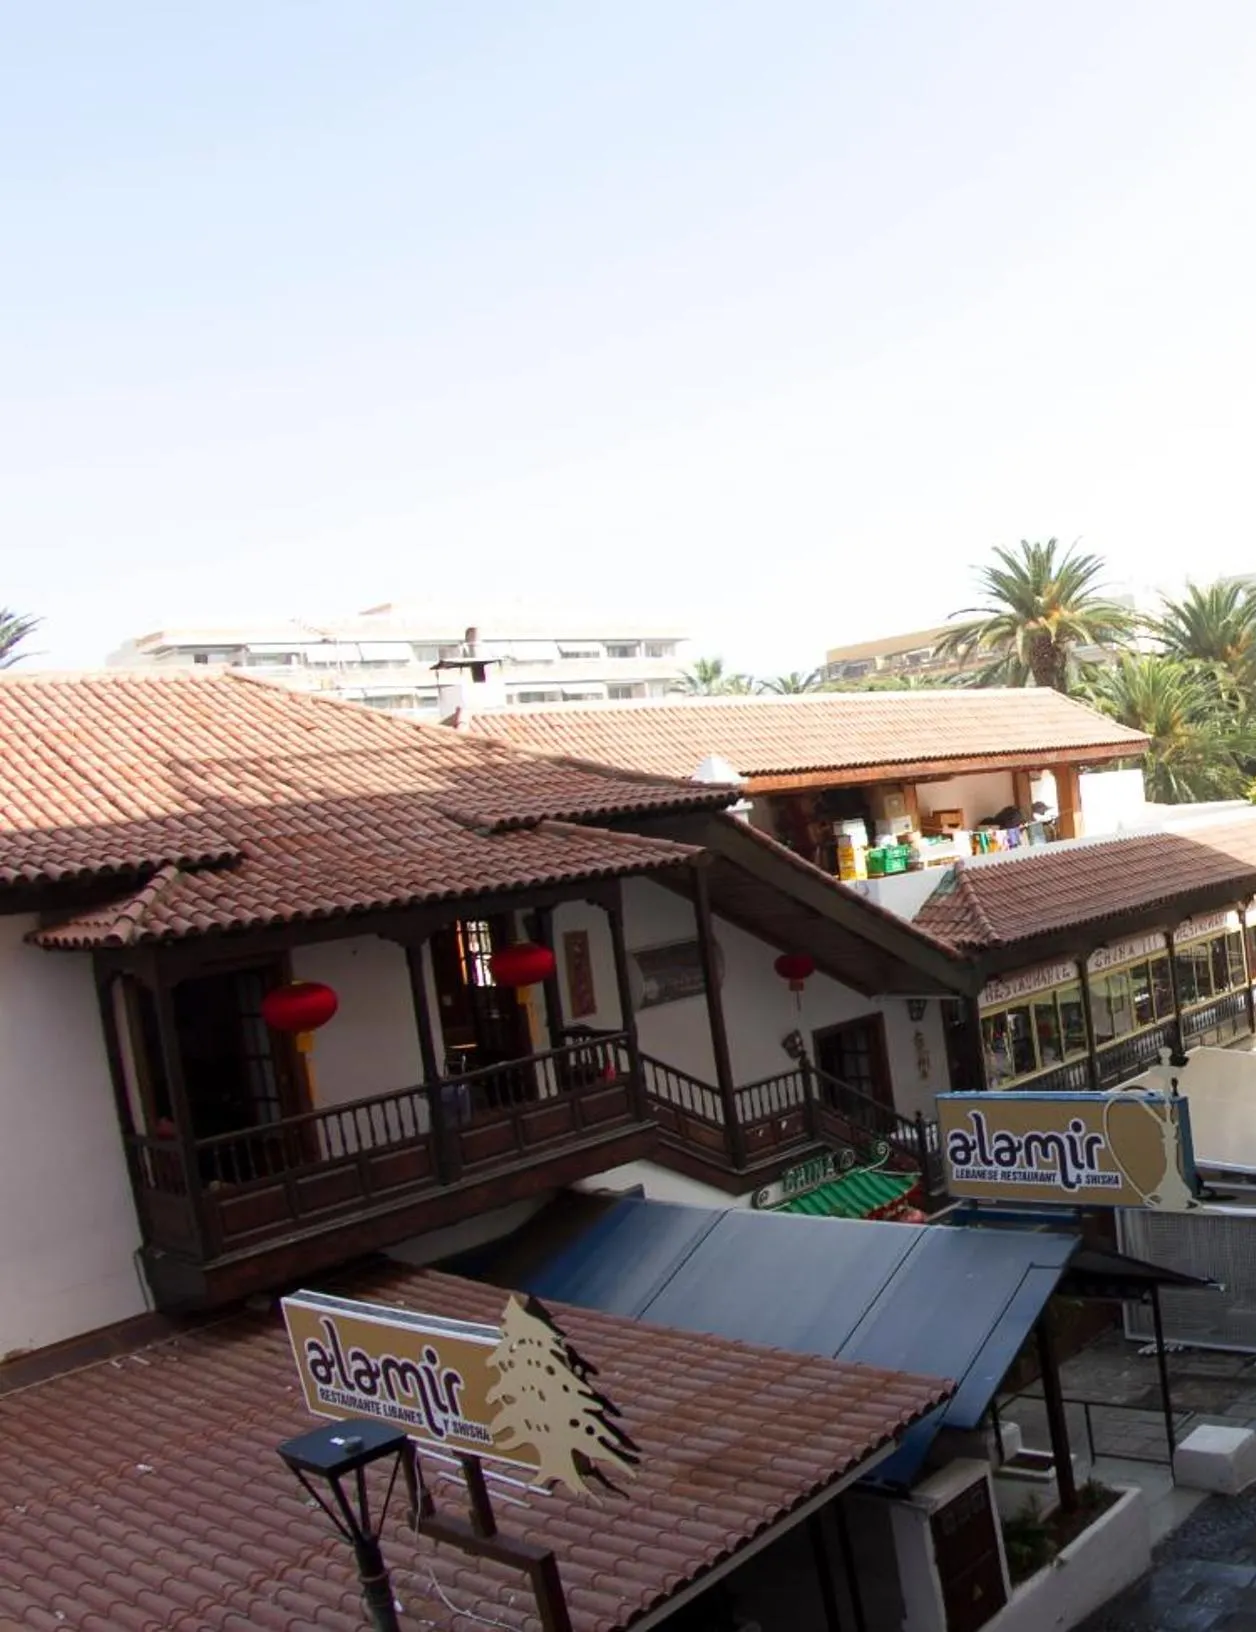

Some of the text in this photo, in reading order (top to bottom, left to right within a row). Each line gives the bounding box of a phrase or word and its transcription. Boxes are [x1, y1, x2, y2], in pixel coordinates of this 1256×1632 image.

[948, 1110, 1104, 1191] alamir
[954, 1168, 999, 1183] LEBANESE
[1000, 1169, 1058, 1185] RESTAURANT
[1084, 1173, 1121, 1187] SHISHA
[306, 1317, 463, 1439] alamir
[318, 1386, 383, 1417] RESTAURANTE
[451, 1418, 491, 1442] SHISHA
